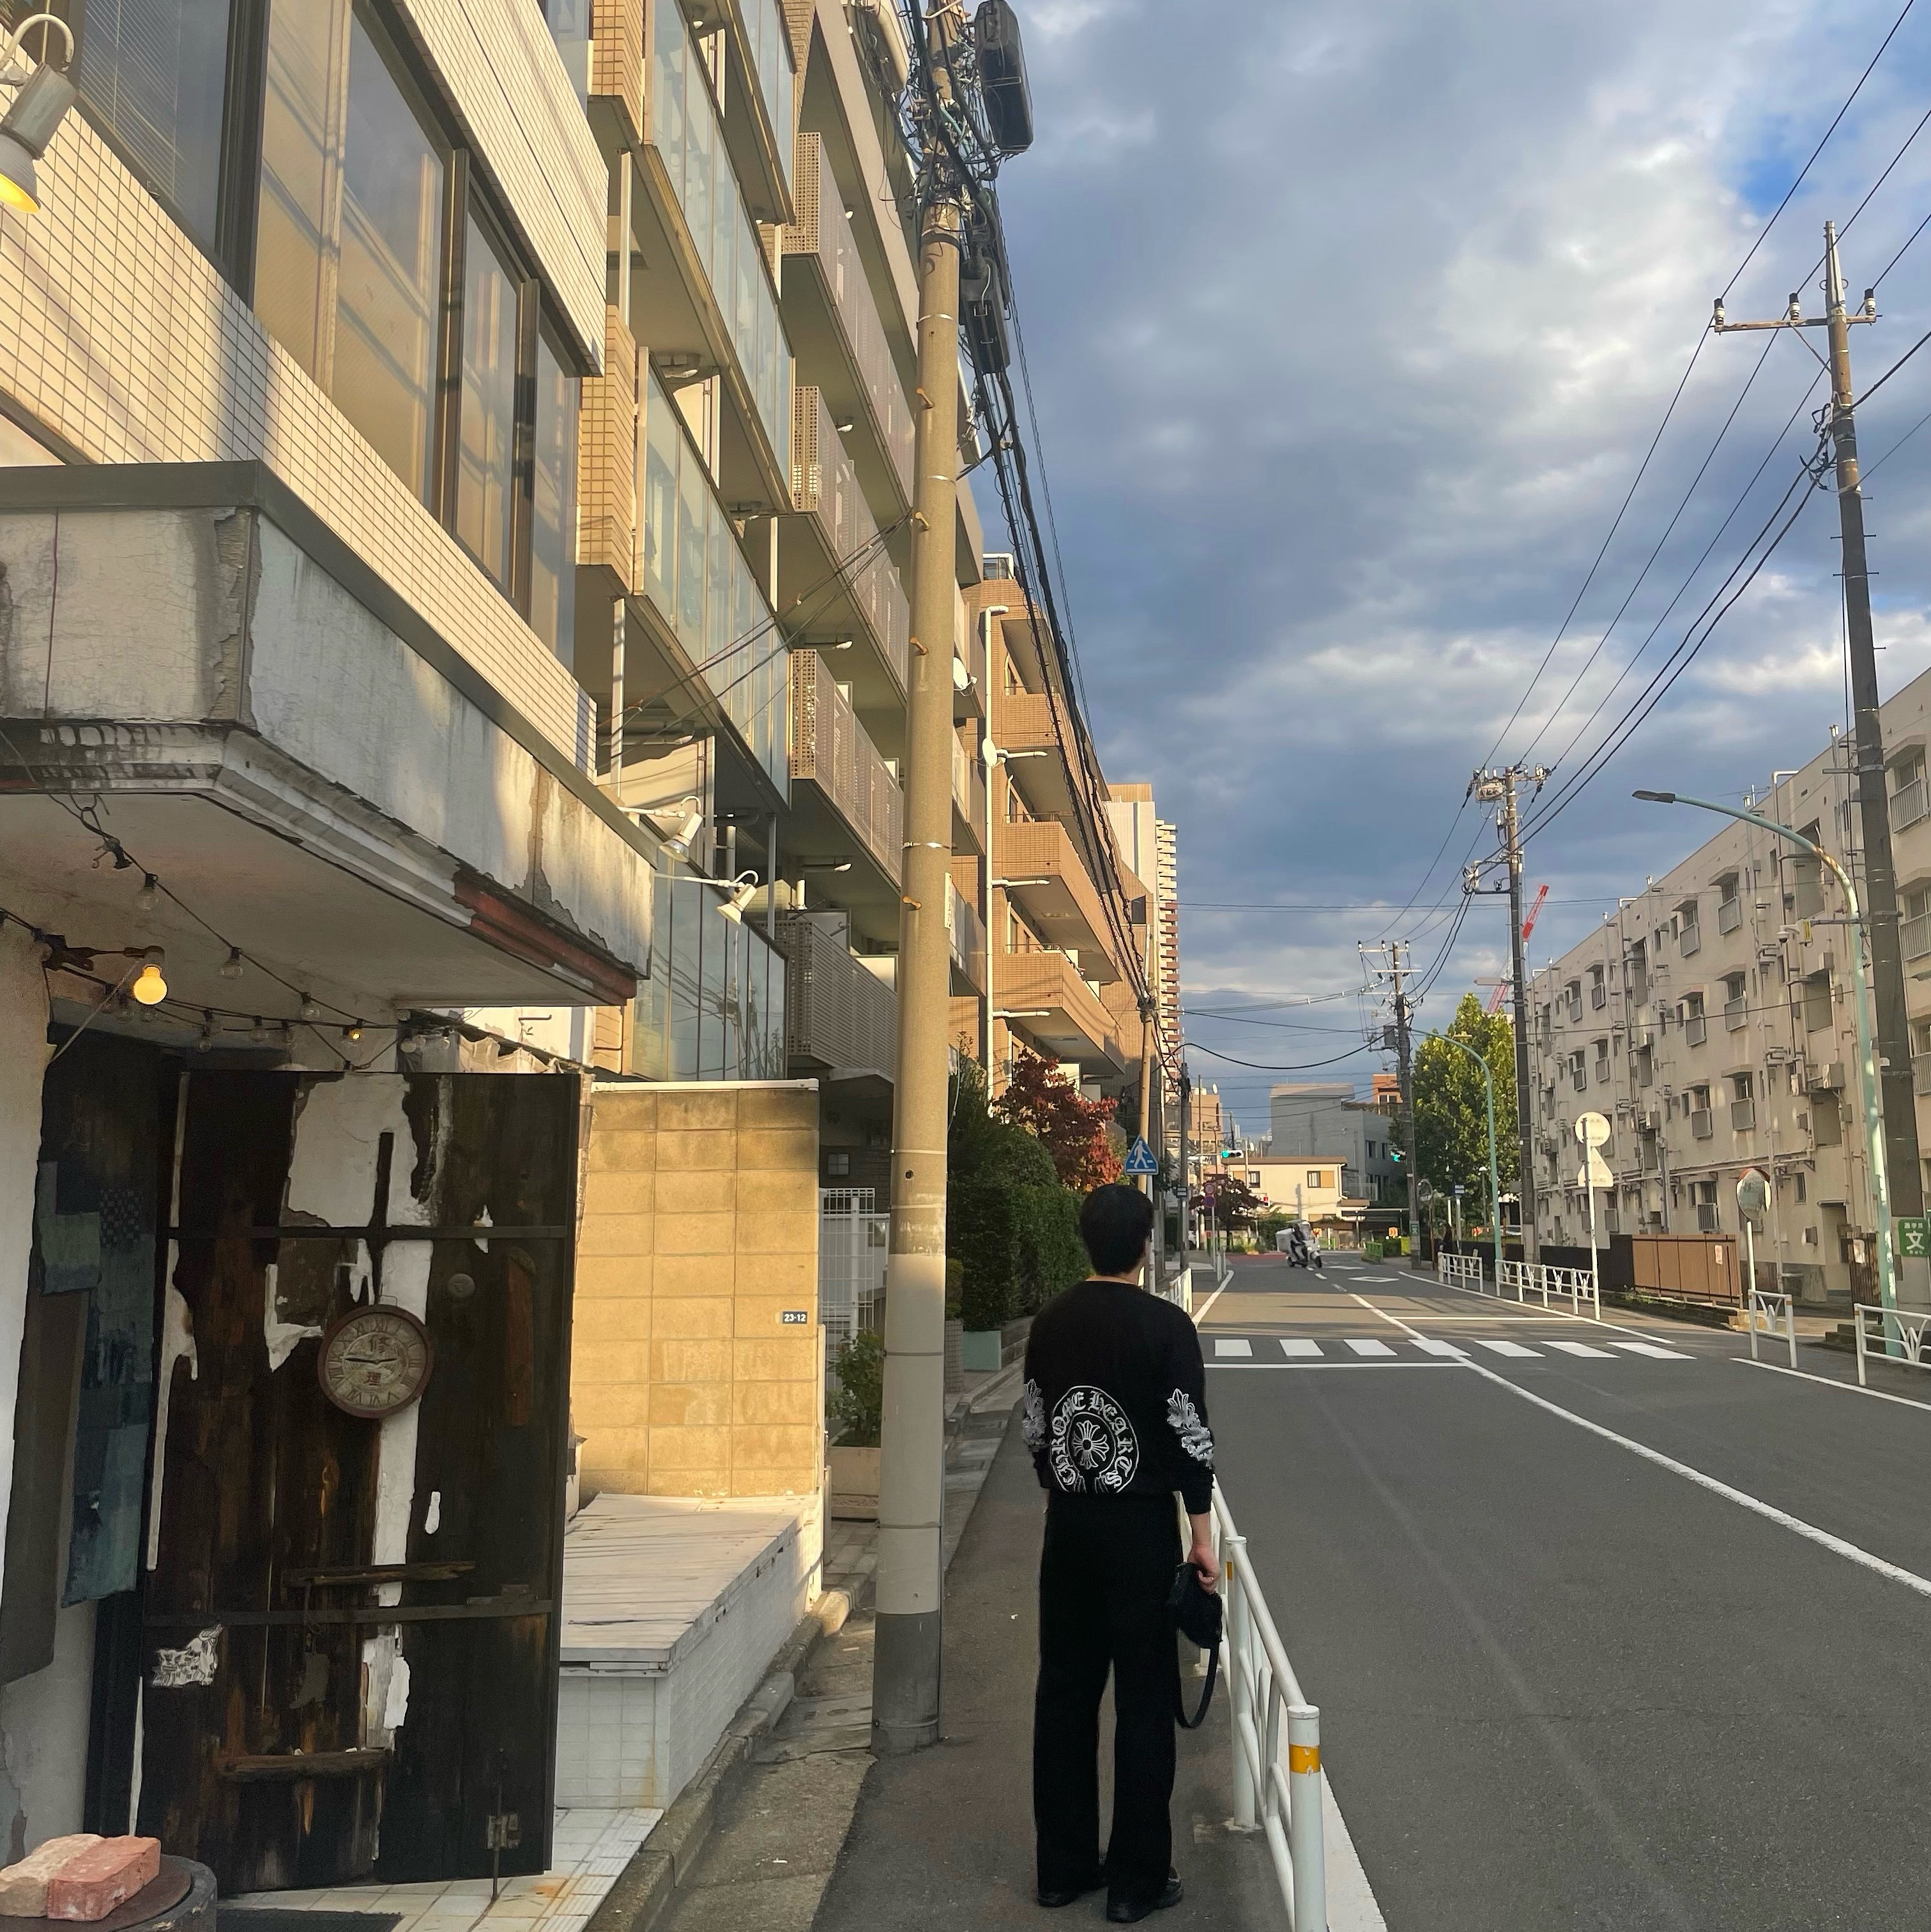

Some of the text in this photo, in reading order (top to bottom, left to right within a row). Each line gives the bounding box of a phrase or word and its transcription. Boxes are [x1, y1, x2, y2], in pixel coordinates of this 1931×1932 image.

[1905, 1230, 1925, 1250] 文
[784, 1313, 806, 1322] 23-12
[1087, 1390, 1134, 1488] HEARTS
